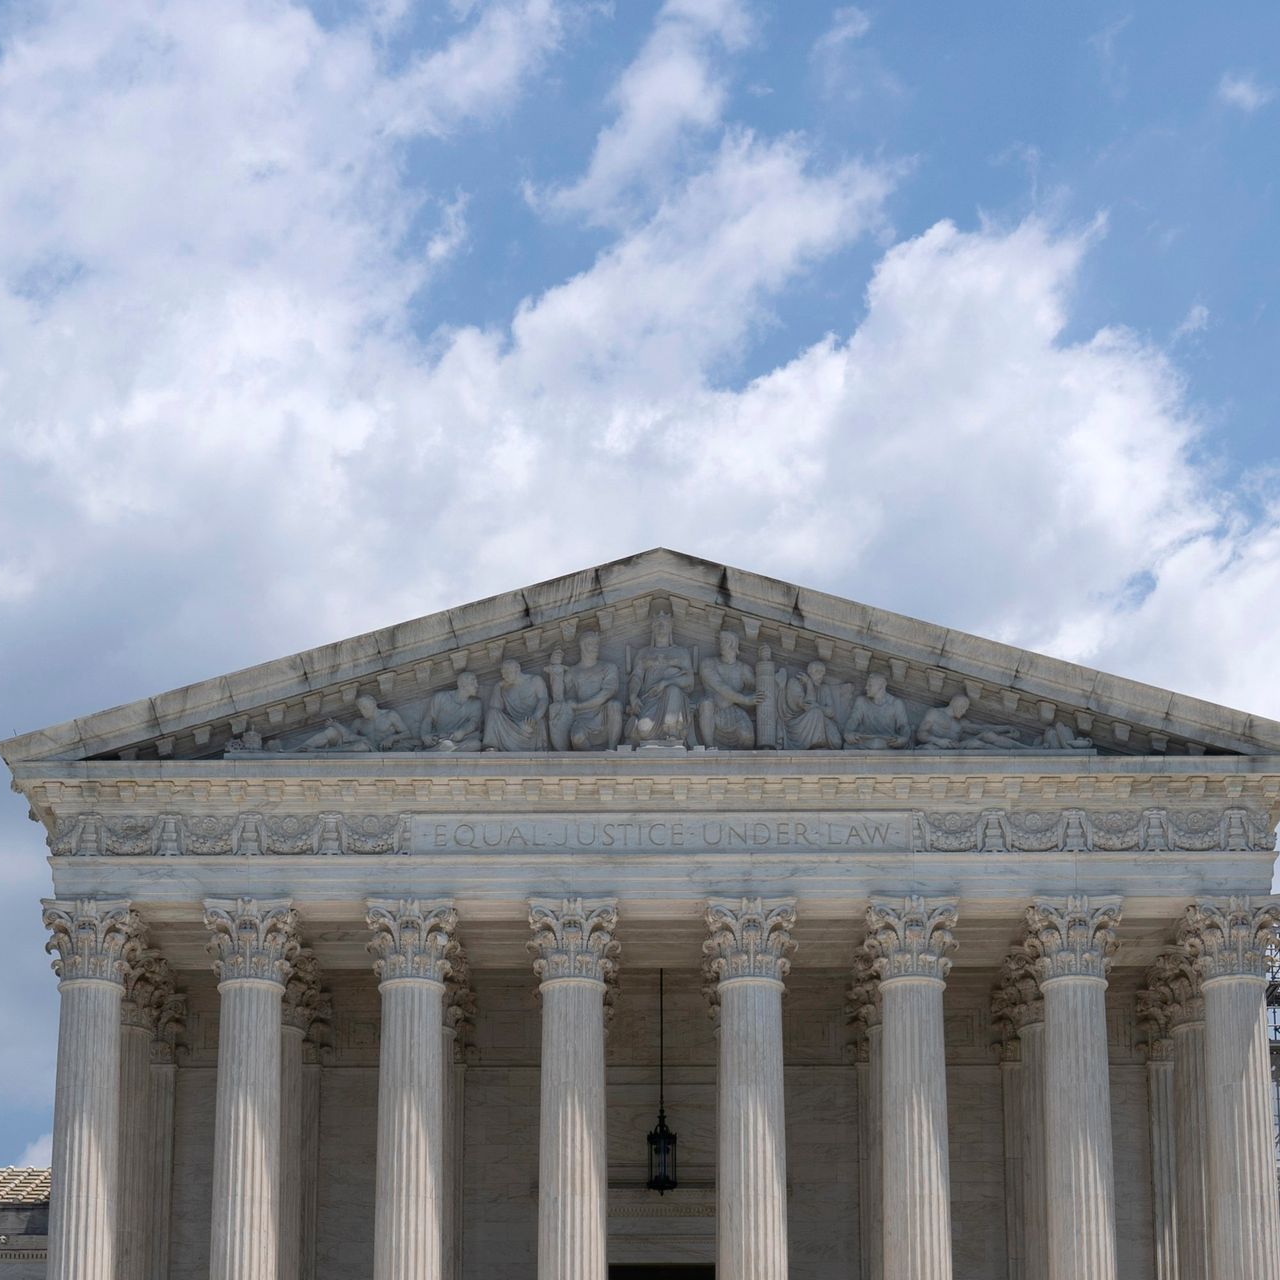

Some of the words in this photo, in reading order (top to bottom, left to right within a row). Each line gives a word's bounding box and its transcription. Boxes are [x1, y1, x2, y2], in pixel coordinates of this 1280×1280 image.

[433, 823, 546, 849] EQUAL
[553, 823, 685, 847] JUSTICE
[701, 822, 817, 847] UNDER
[825, 822, 892, 846] LAW
